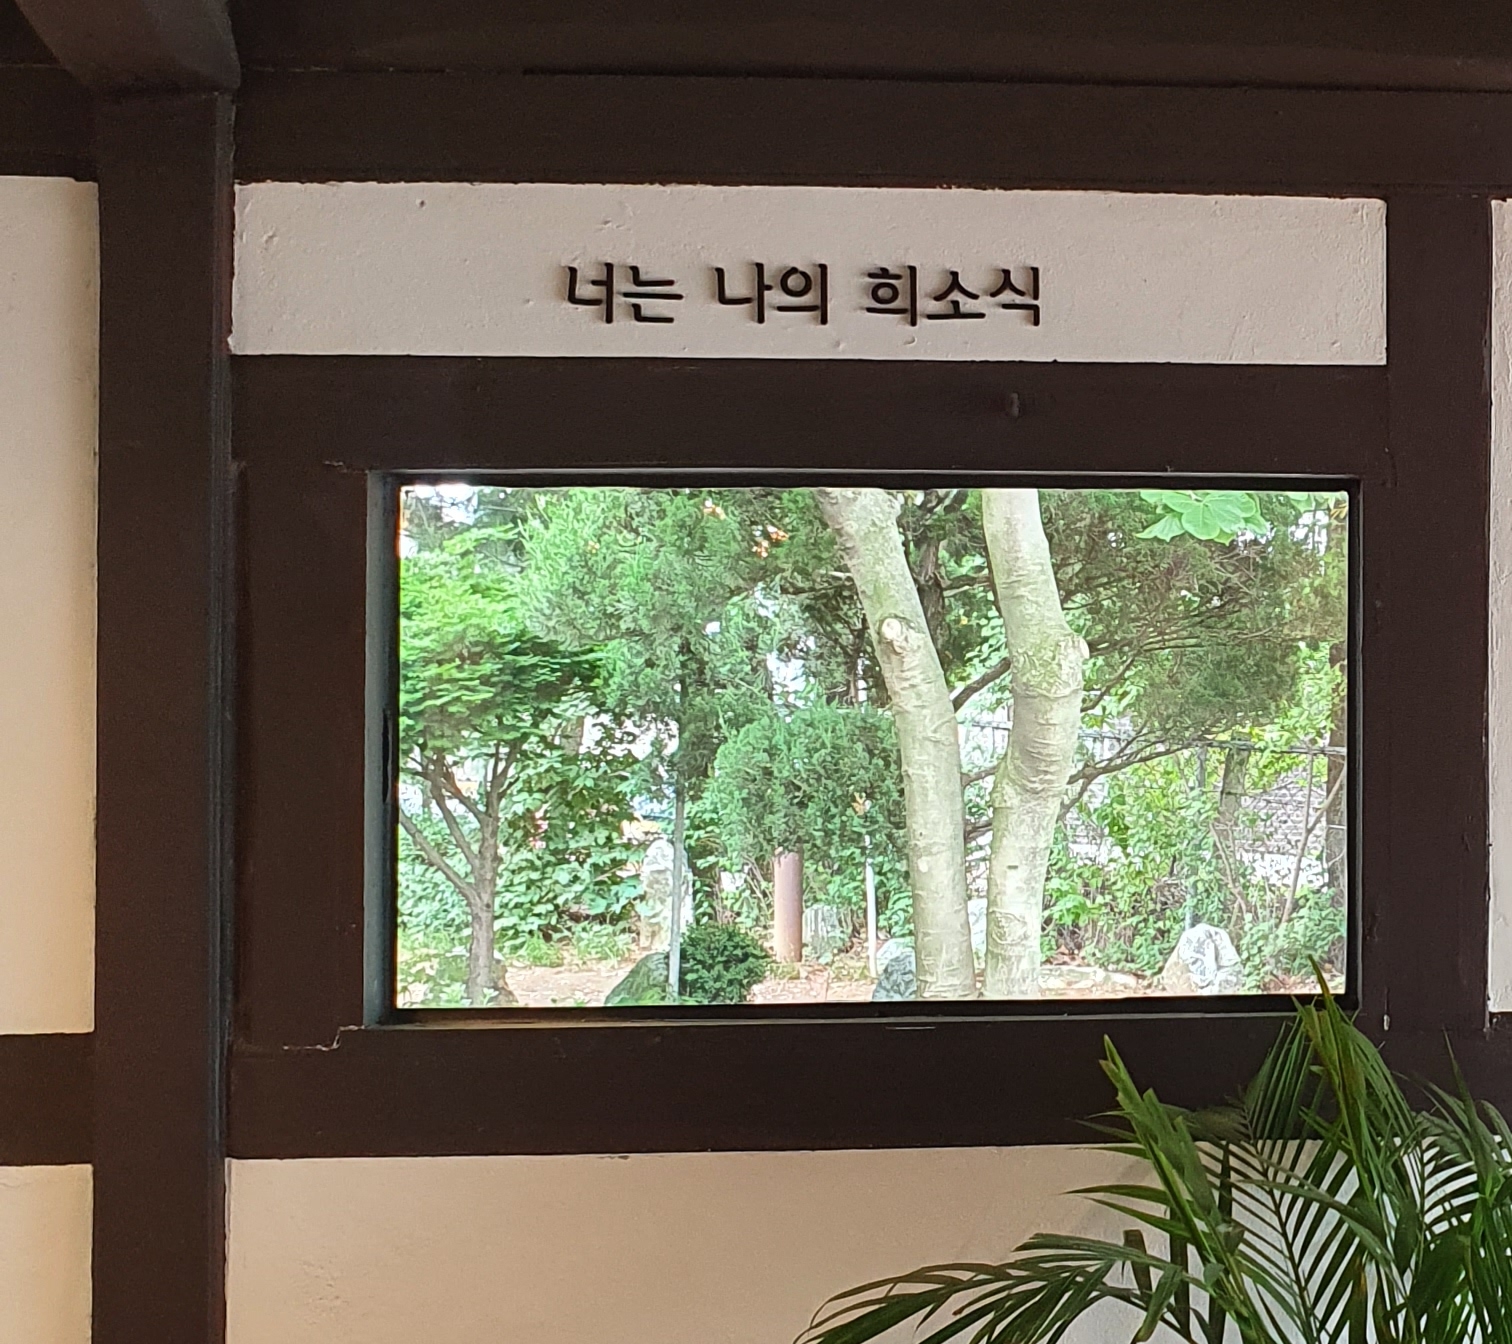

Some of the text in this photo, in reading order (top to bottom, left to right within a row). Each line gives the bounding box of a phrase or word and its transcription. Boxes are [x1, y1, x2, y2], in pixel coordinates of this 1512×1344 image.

[567, 261, 1040, 327] 너는 나의 희소식
